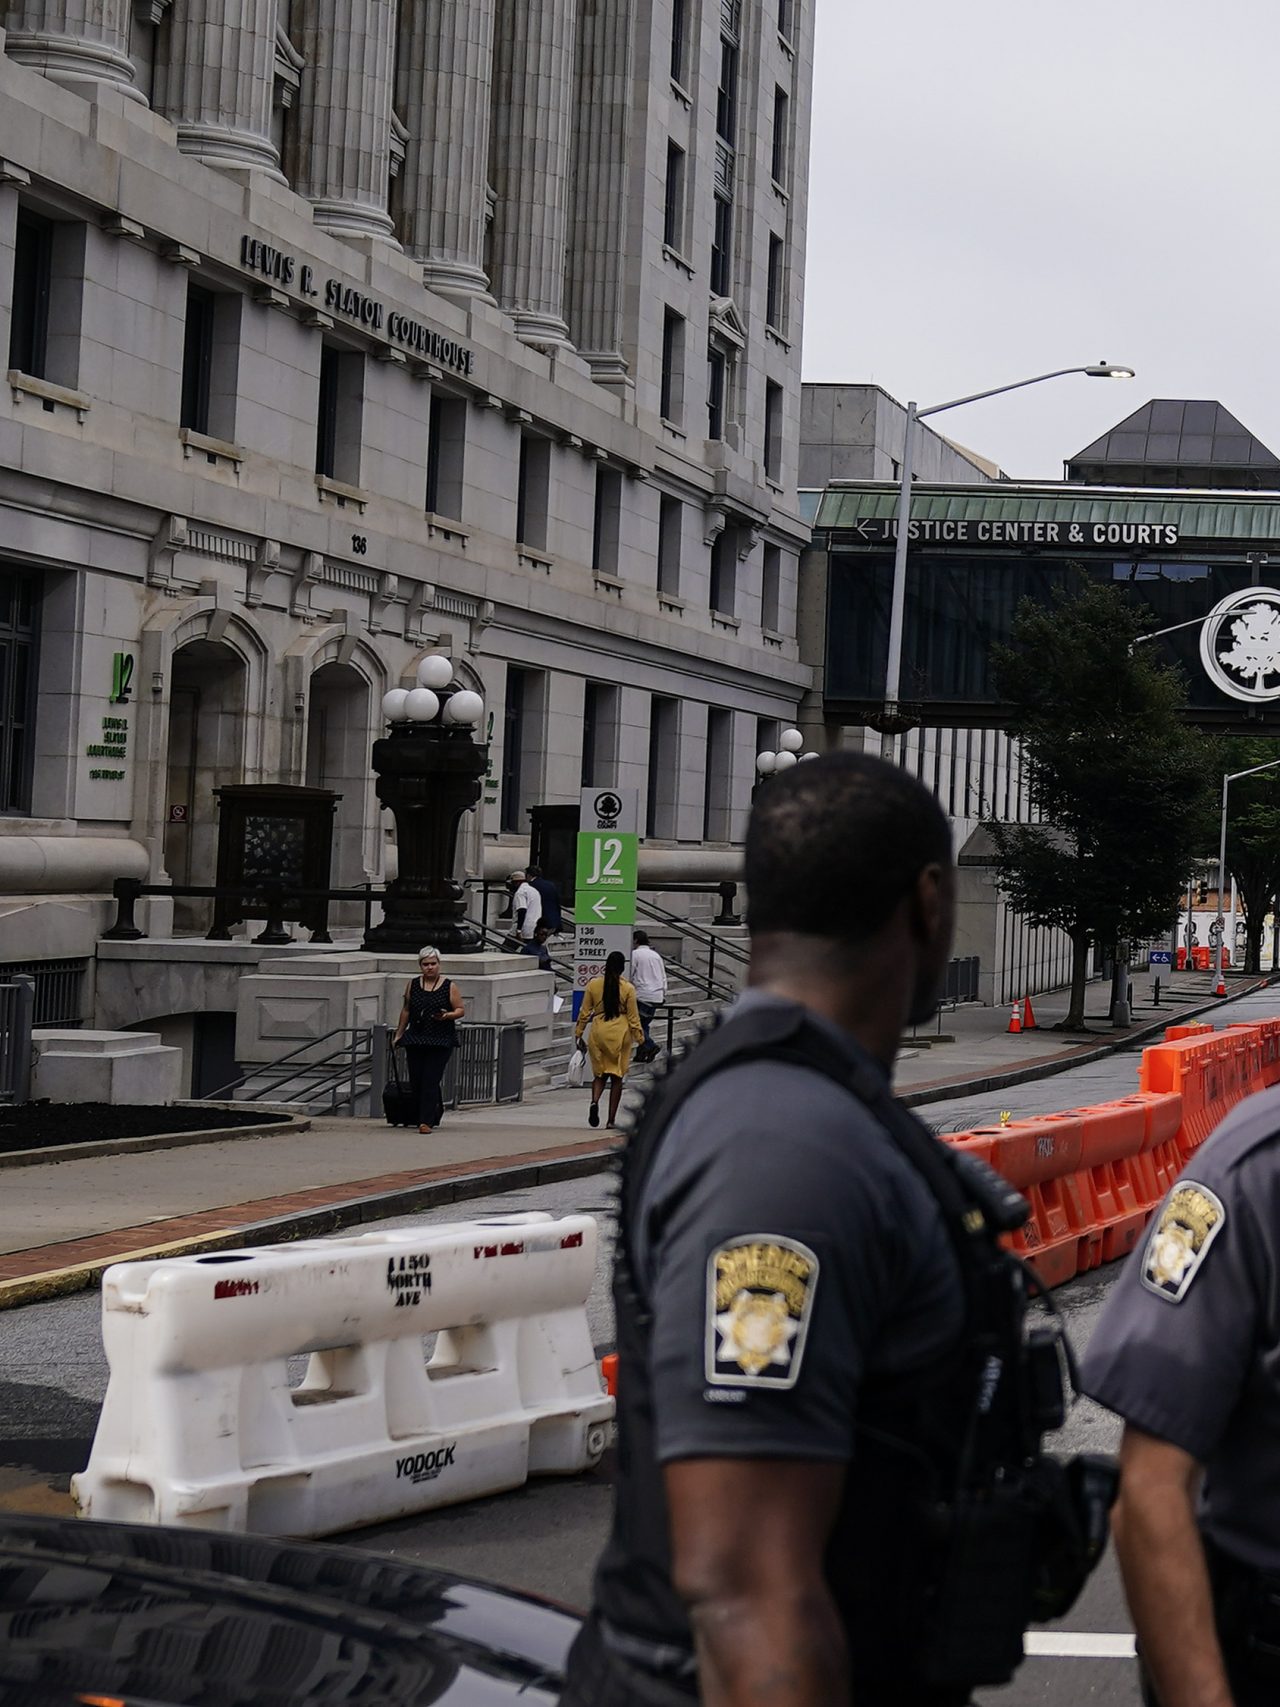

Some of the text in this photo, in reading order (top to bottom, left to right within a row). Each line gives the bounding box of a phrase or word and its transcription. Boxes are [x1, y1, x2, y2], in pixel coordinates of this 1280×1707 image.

[241, 235, 295, 284] LEWIS
[326, 279, 384, 329] SLATON
[388, 312, 475, 375] COURTHOUSE
[977, 521, 1060, 542] CENTER
[1068, 523, 1084, 543] &
[1092, 523, 1178, 545] COURTS
[351, 534, 367, 556] 136
[585, 838, 623, 884] J2
[580, 927, 595, 935] 136
[579, 938, 604, 946] PRYOR
[579, 948, 607, 956] STREET
[387, 1272, 431, 1288] NORTH
[395, 1290, 421, 1307] AVE
[396, 1442, 456, 1478] YODOCK
